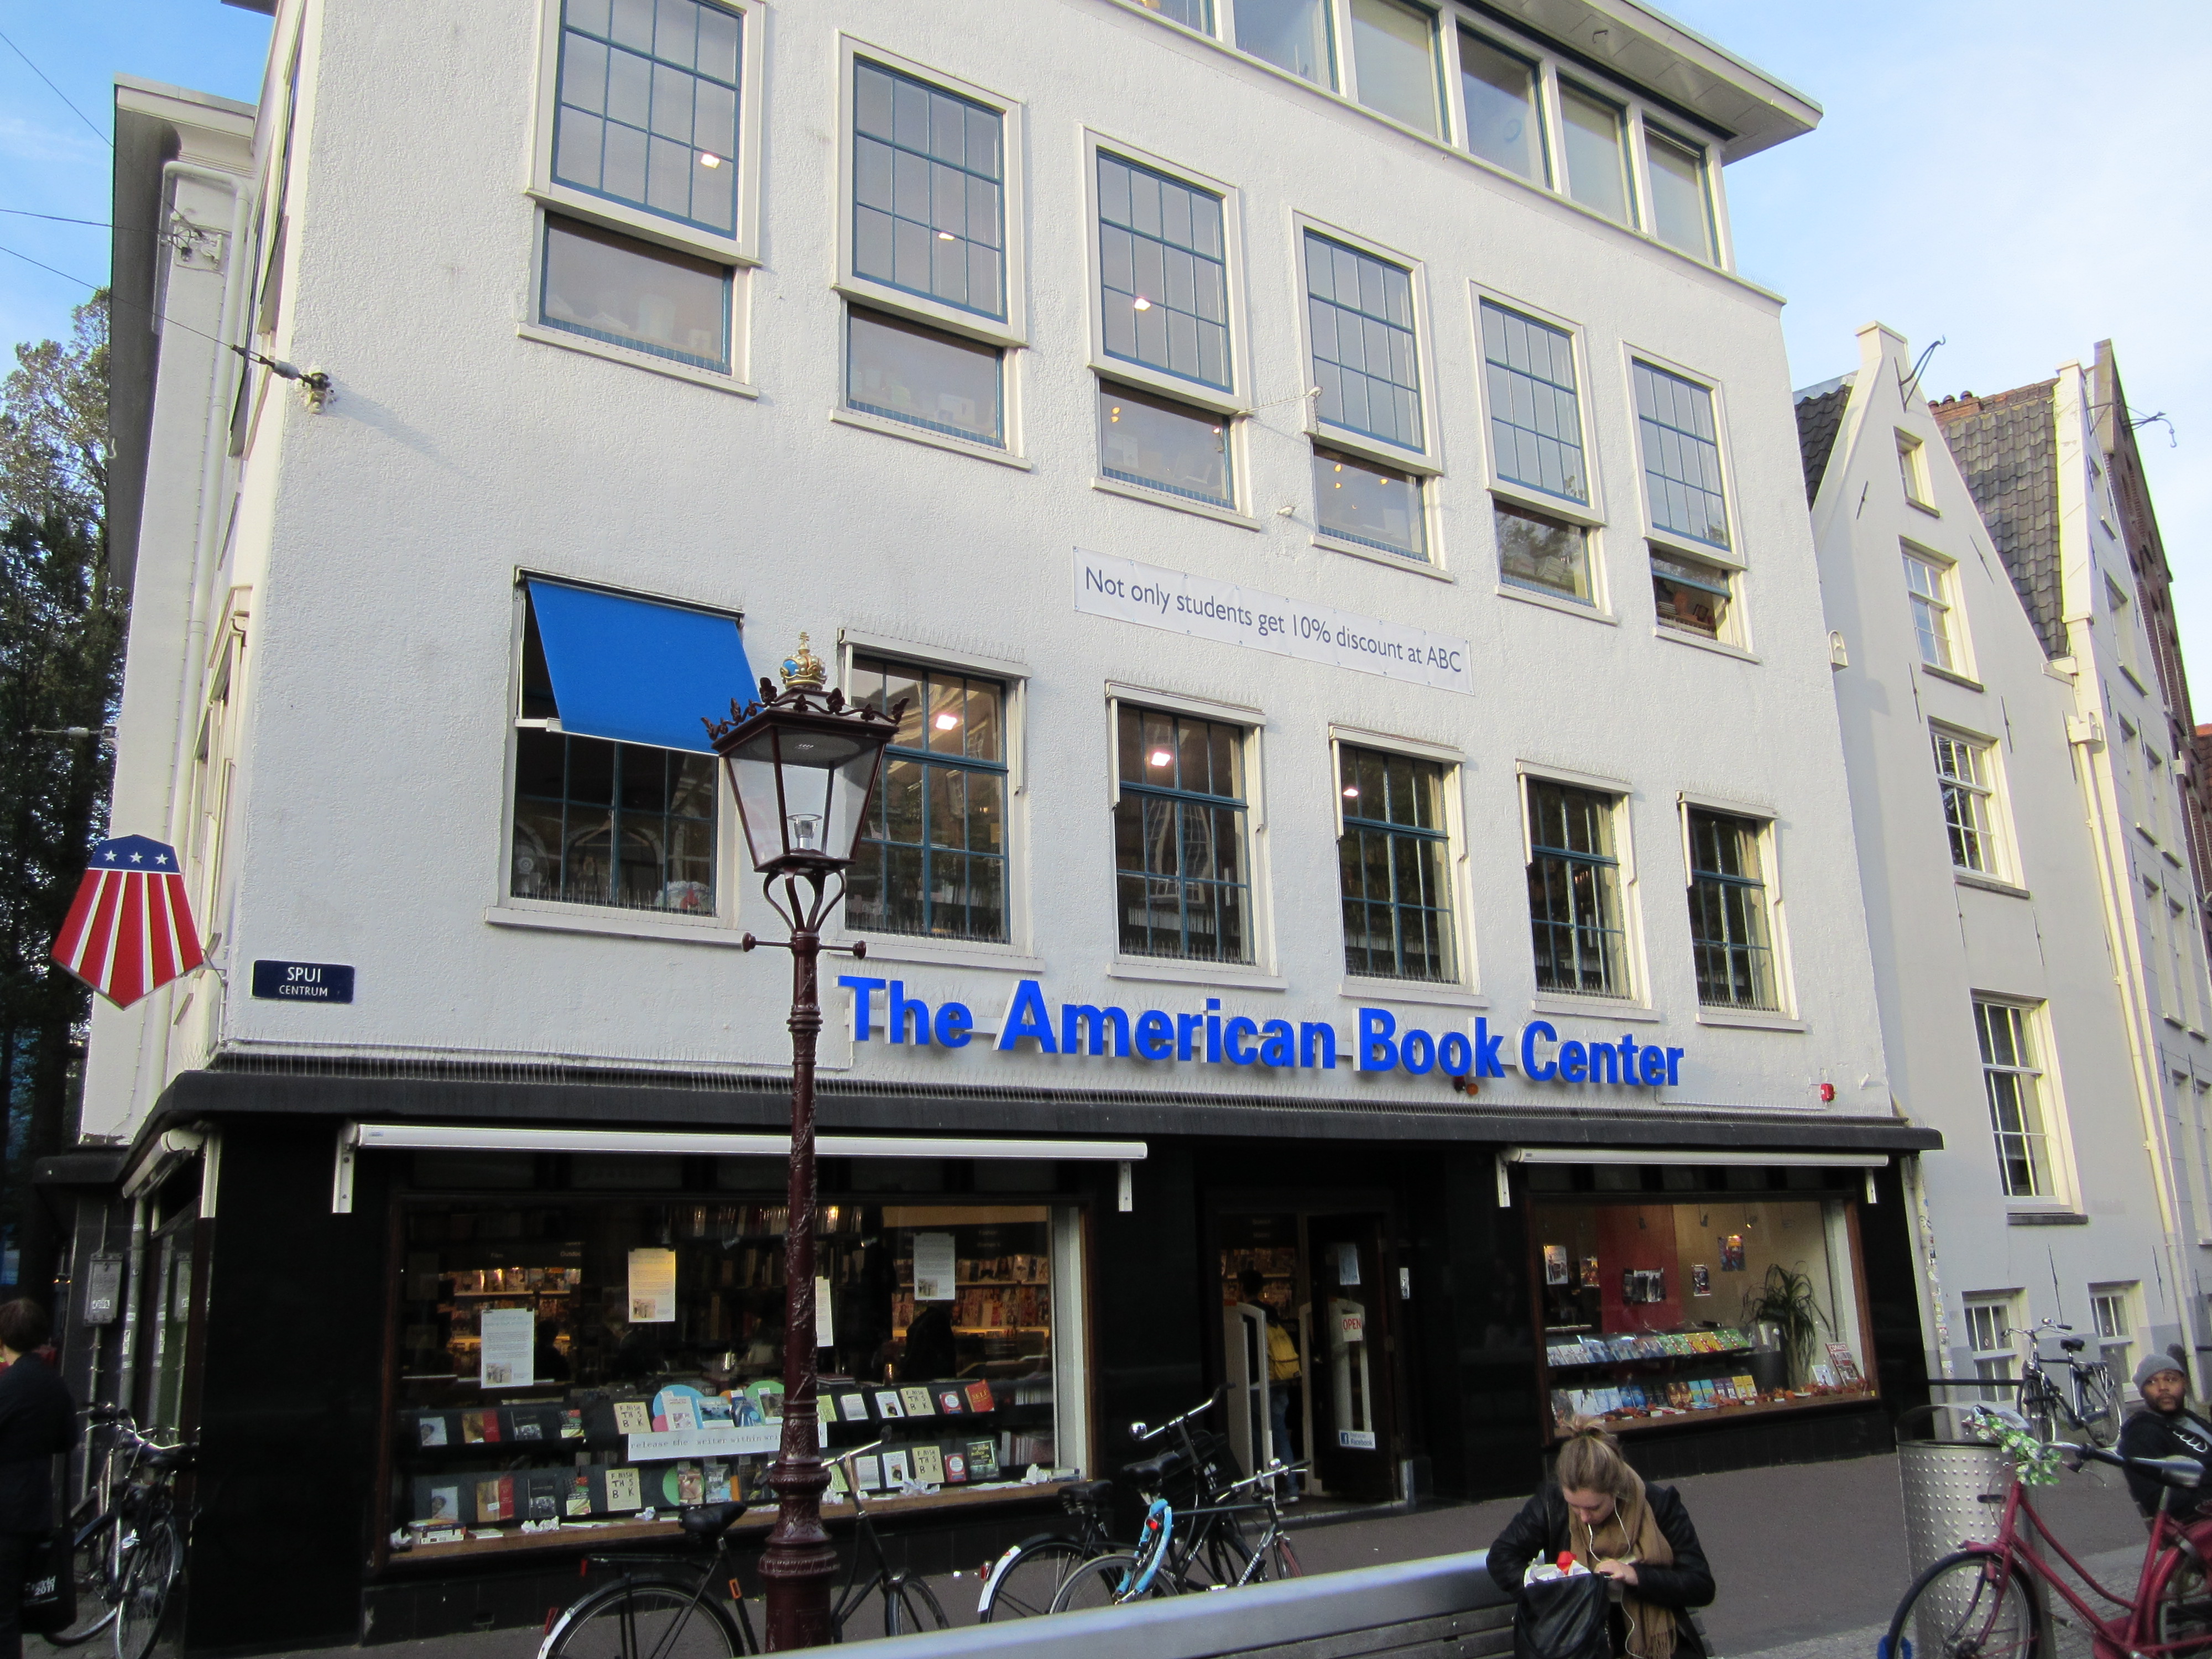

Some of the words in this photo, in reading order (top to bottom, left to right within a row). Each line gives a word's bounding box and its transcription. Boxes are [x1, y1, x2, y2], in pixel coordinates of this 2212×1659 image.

[1086, 566, 1124, 598] Not
[1131, 582, 1171, 614] only
[1176, 595, 1253, 626] students
[1258, 614, 1285, 637] get
[1293, 614, 1331, 643] 10%
[1336, 625, 1404, 660] discount
[1407, 648, 1423, 664] at
[1427, 645, 1462, 672] ABC
[286, 967, 321, 983] SPUI
[279, 985, 328, 997] CENTRUM
[834, 975, 973, 1048] The
[994, 979, 1336, 1070] American
[1353, 1008, 1506, 1078] Book
[1515, 1020, 1684, 1087] Center
[1343, 1318, 1361, 1331] OPEN
[972, 1389, 988, 1400] SELF
[630, 1441, 669, 1449] release
[696, 1437, 727, 1446] writer
[731, 1435, 762, 1444] within
[34, 1584, 54, 1597] 2011
